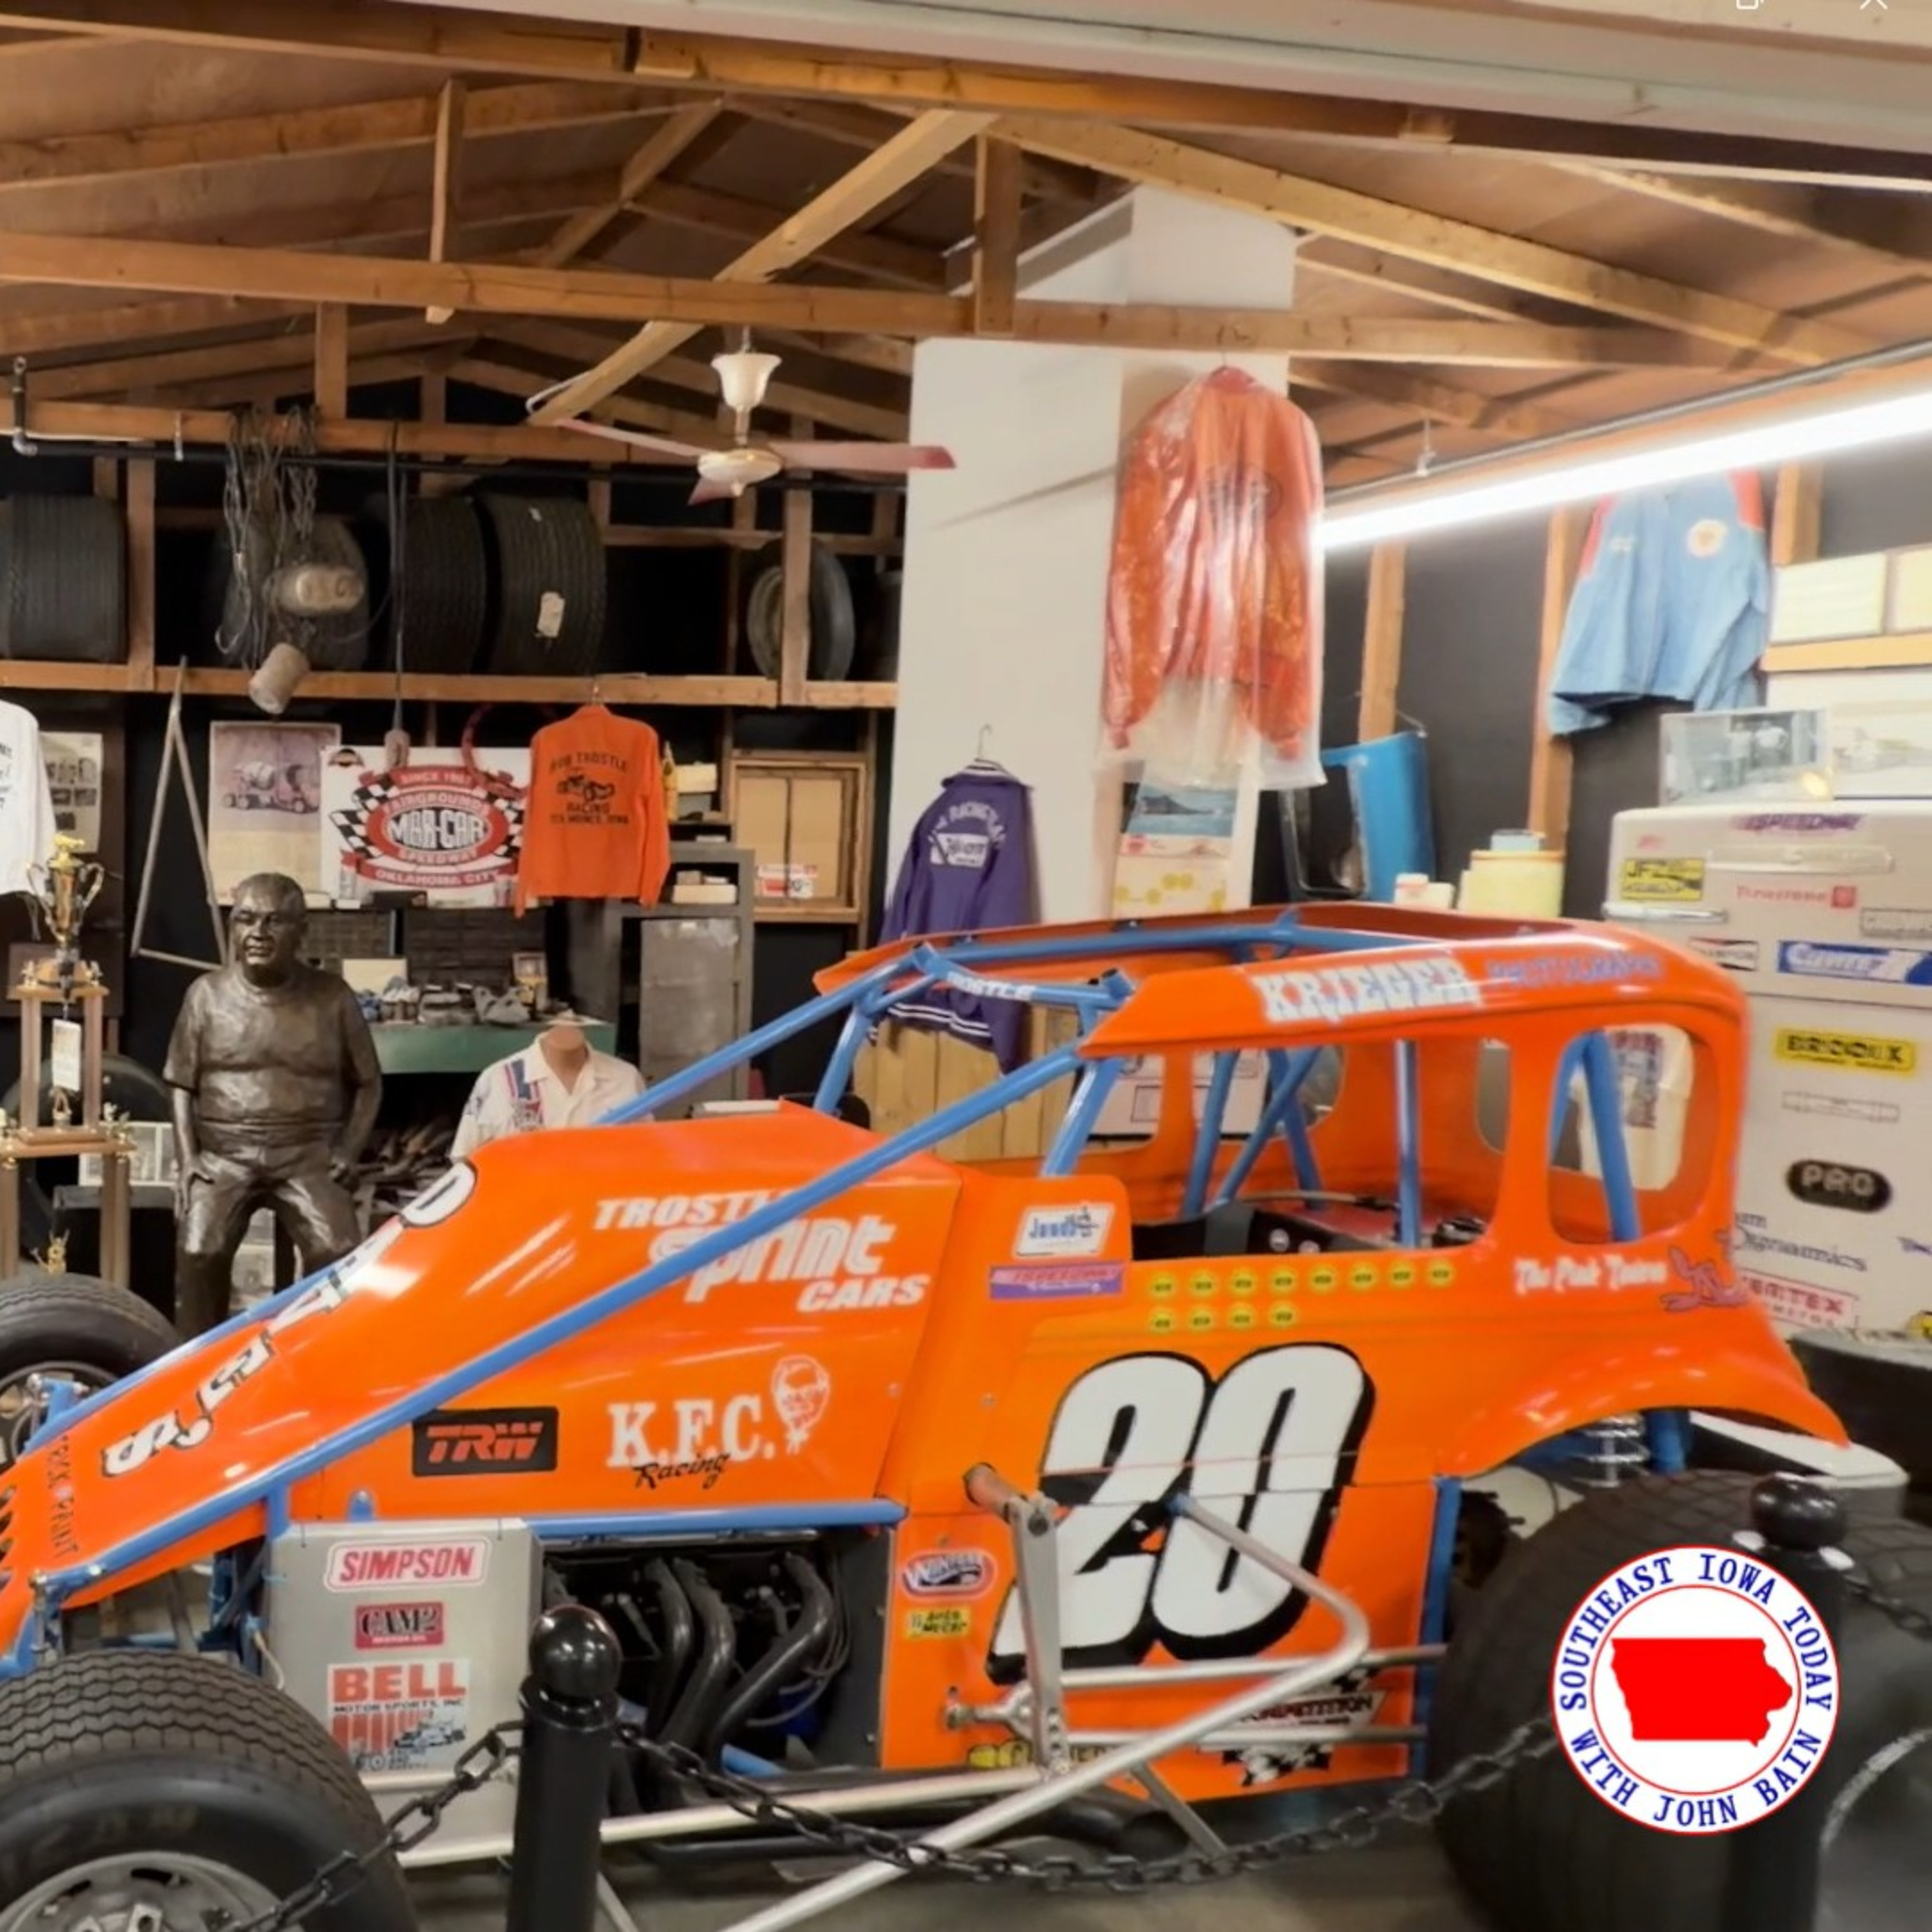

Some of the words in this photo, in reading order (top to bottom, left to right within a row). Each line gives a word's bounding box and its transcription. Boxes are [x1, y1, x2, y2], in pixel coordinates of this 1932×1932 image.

[375, 869, 462, 885] OKLAHOMA
[464, 871, 500, 884] CITY
[1253, 957, 1484, 1024] KRIEGER
[1801, 1163, 1876, 1197] PRO
[592, 1189, 797, 1230] TROST
[795, 1274, 931, 1312] CARS
[1741, 1275, 1843, 1315] ERTEX
[426, 1422, 543, 1463] TRW
[607, 1394, 777, 1468] K.F.C.
[633, 1453, 732, 1489] Racing
[985, 1341, 1376, 1685] 20
[339, 1546, 476, 1583] SIMPSON
[332, 1662, 466, 1703] BELL
[334, 1703, 381, 1712] MOTOR
[1238, 1695, 1374, 1723] OMPETITION
